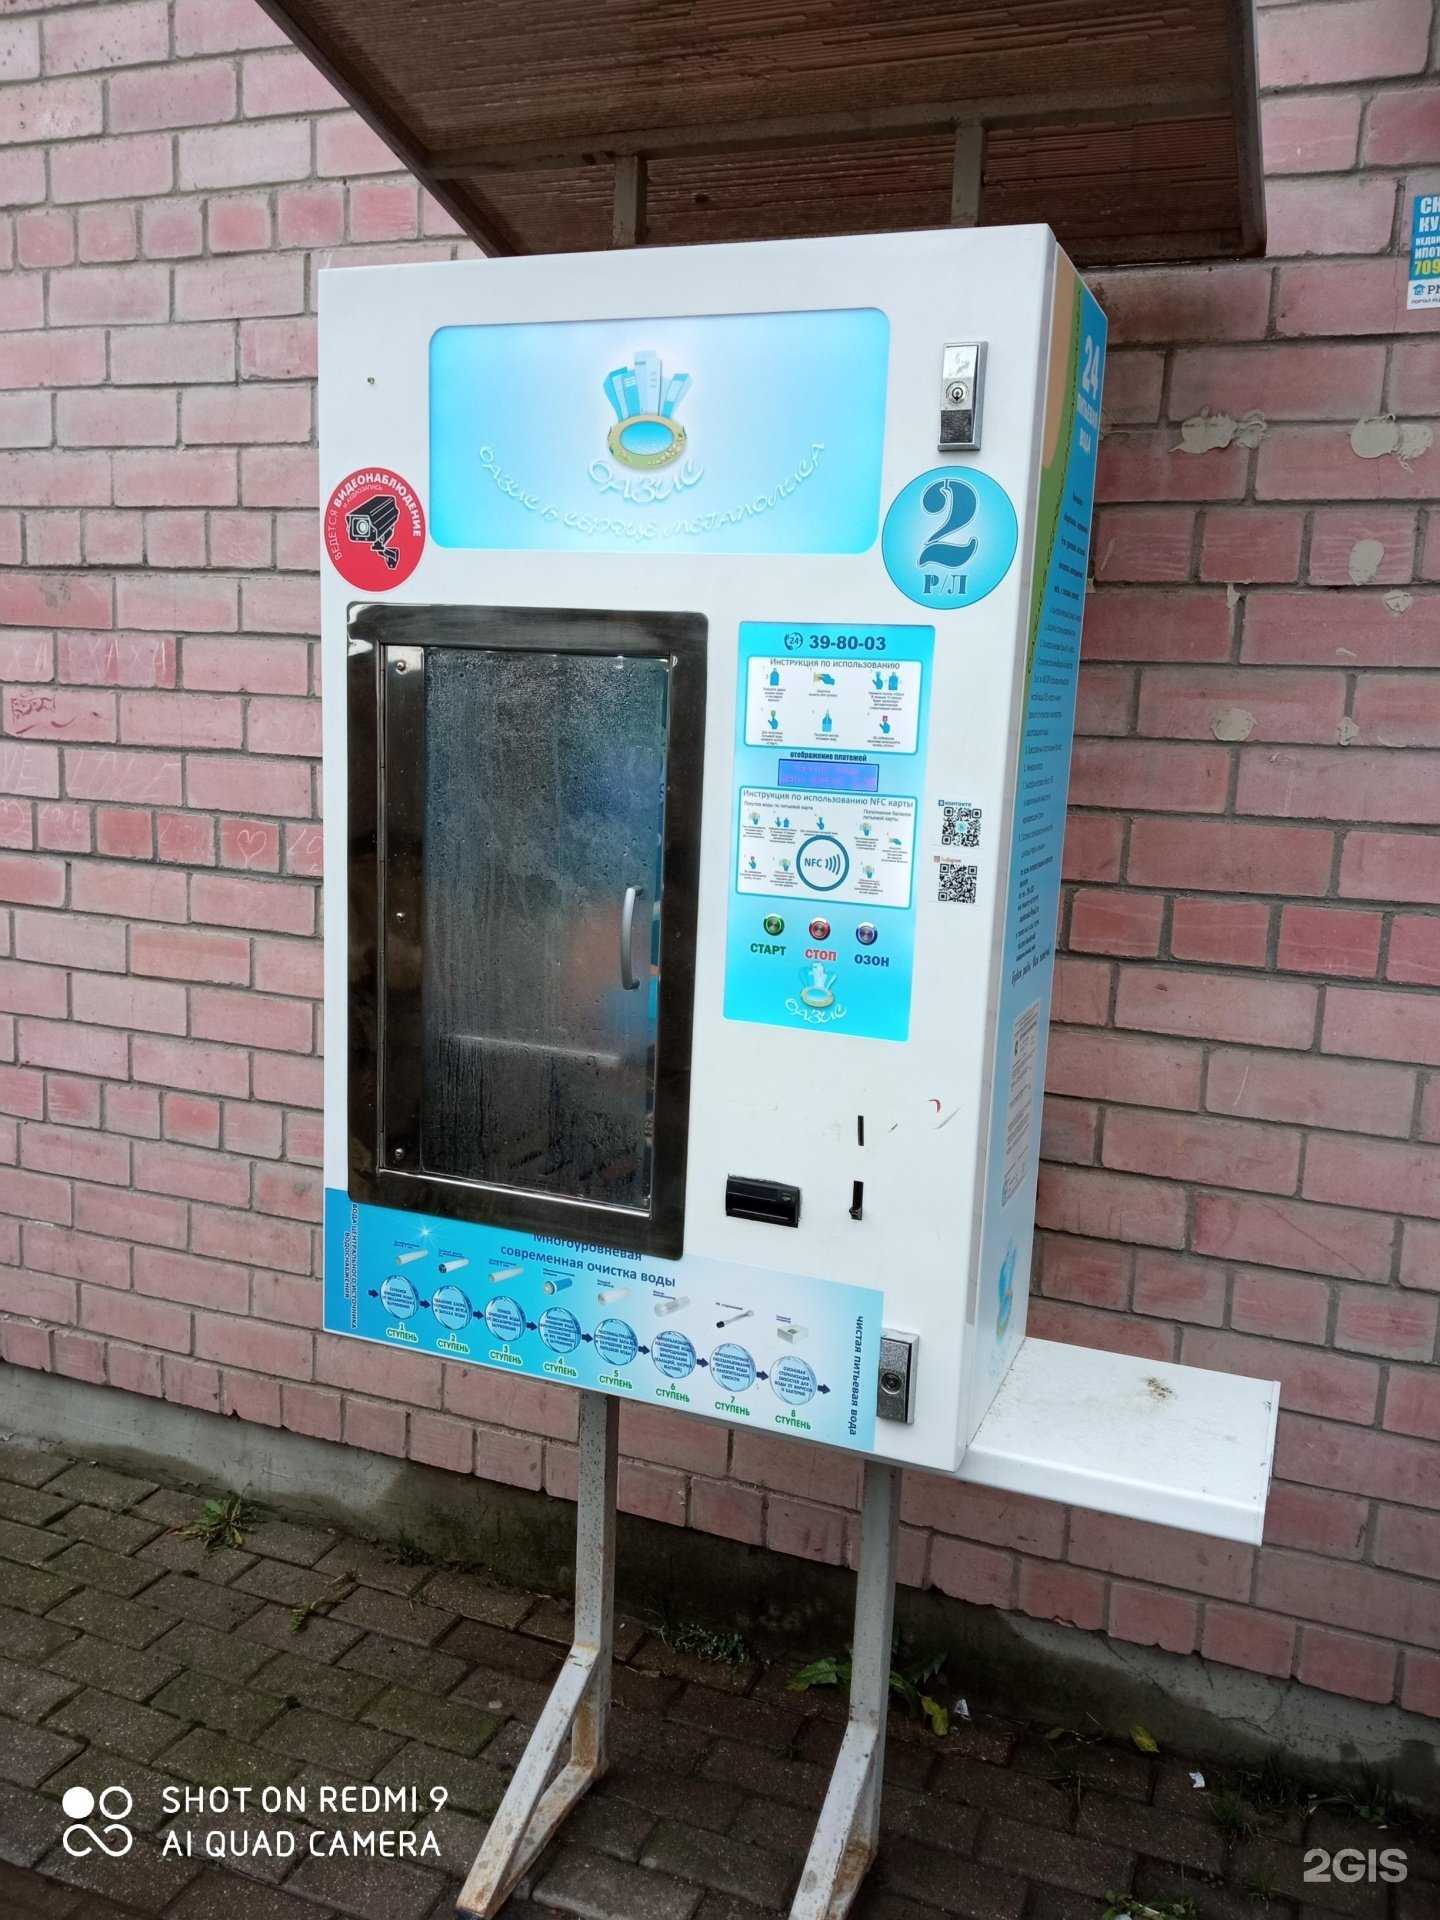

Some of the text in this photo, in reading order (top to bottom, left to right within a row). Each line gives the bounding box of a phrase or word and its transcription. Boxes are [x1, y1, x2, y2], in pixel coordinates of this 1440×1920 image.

[333, 473, 421, 538] ВИДЕОНАБЛЮДЕНИЕ
[918, 478, 979, 569] 2
[809, 635, 886, 651] 39-80-03
[743, 789, 914, 809] Инструкция по использованию NFC карты
[804, 857, 823, 868] NFC
[750, 943, 786, 956] СТАРТ
[804, 948, 837, 961] СТОП
[854, 954, 890, 967] ОЗОН
[500, 1246, 584, 1269] современная
[587, 1262, 637, 1280] очистка
[641, 1272, 675, 1288] воды
[387, 1329, 418, 1342] СТУПЕНЬ
[437, 1340, 469, 1353] СТУПЕНЬ
[490, 1351, 522, 1364] СТУПЕНЬ
[544, 1363, 577, 1377] СТУПЕНЬ
[847, 1315, 864, 1436] чистая питьевая вода
[599, 1375, 632, 1389] СТУПЕНЬ
[656, 1388, 690, 1403] СТУПЕНЬ
[715, 1401, 750, 1416] СТУПЕНЬ
[775, 1415, 811, 1430] СТУПЕНЬ
